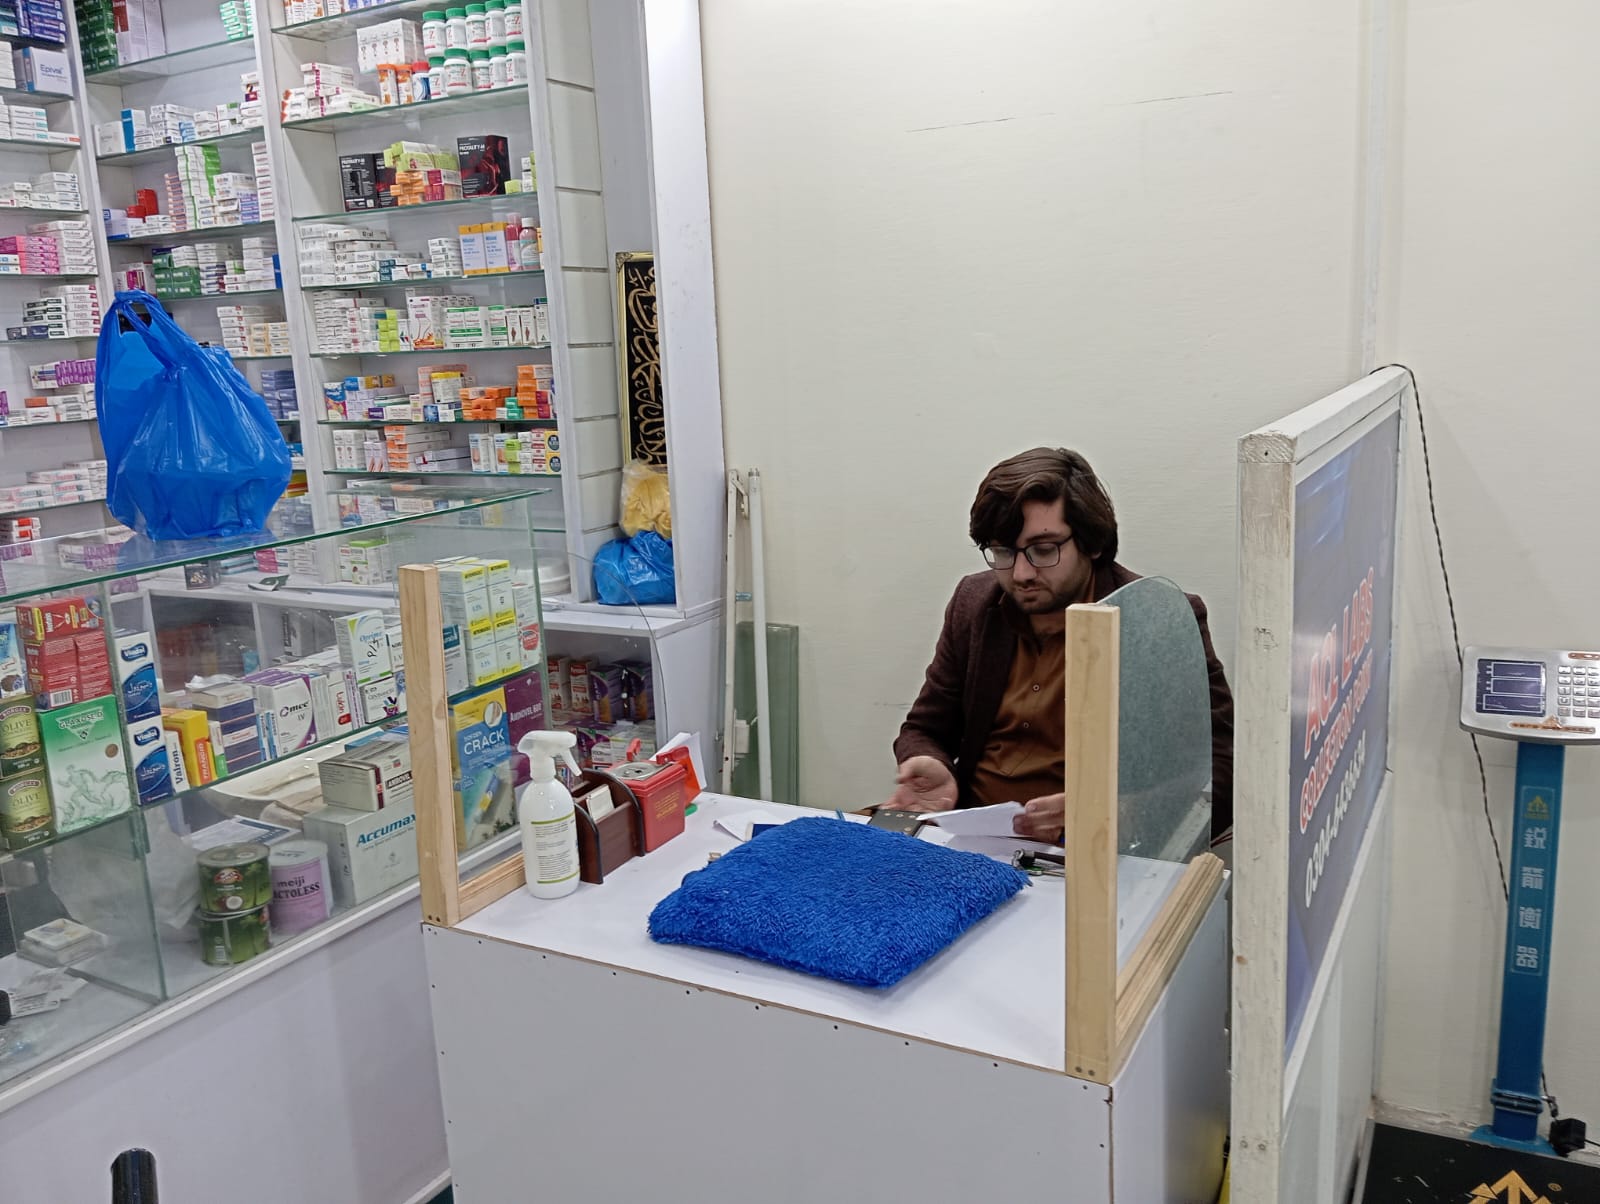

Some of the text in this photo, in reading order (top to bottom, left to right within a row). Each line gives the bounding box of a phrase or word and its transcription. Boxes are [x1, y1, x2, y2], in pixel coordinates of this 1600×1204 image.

[1303, 623, 1339, 760] ACL
[2, 719, 33, 732] OLIVE
[463, 728, 506, 755] CRACK
[272, 881, 321, 899] ACTOLESS
[278, 875, 305, 888] meiji
